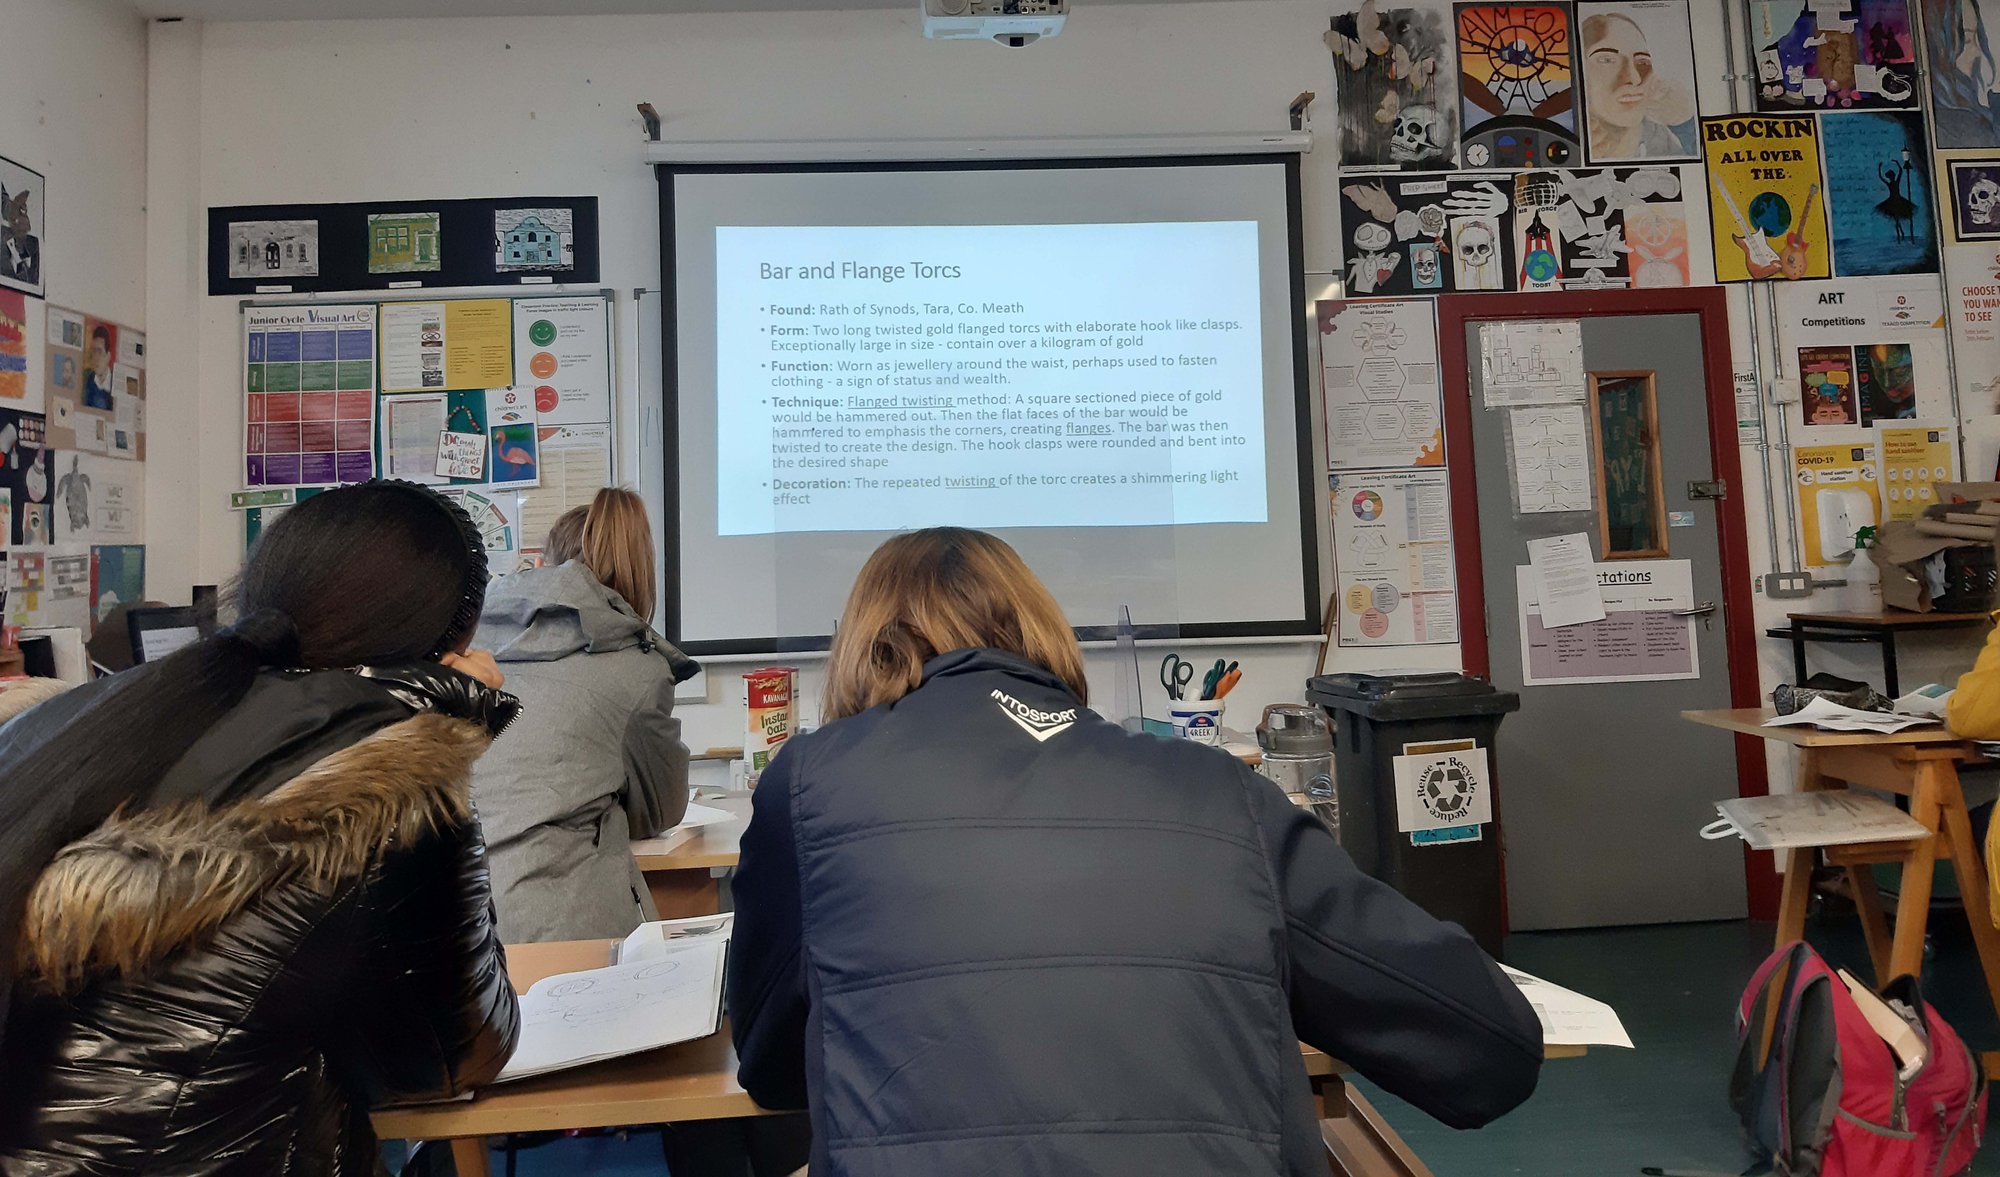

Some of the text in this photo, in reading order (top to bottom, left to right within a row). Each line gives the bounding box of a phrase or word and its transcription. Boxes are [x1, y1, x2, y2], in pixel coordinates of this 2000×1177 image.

[1461, 8, 1565, 51] AIM FOR
[1486, 71, 1559, 110] PEACE
[1705, 120, 1812, 141] ROCKIN
[1721, 150, 1803, 164] ALL OVER
[760, 261, 961, 283] Bar and Flange Torcs
[1818, 292, 1846, 305] ART
[1962, 286, 1996, 297] CHOOSE
[770, 301, 1024, 317] Found: Rath of Synods, Tara, Co. Meath
[1963, 299, 1981, 309] YOU
[250, 309, 356, 326] Junior Cycle Visual Art
[1801, 316, 1867, 329] Competitions
[1965, 311, 1992, 322] TO SEE
[770, 317, 1242, 338] Form: Two long twisted gold flanged torcs with elaborate hook like clasps.
[771, 334, 1143, 354] Exceptionally large in size contain over a kilogram of gold
[771, 353, 1217, 373] Function: Worn as jewellery around the waist, perhaps used to fasten
[771, 372, 1011, 390] clothing a sign of status and wealth.
[1857, 346, 1873, 412] IMAGINE
[771, 388, 1221, 410] Technique: Flanged twisting method: A square sectioned piece of gold
[771, 404, 1188, 423] would be hammered out. Then the flat faces of the bar would be
[847, 426, 861, 438] to
[864, 424, 926, 439] emphasis
[929, 423, 951, 436] the
[954, 426, 1007, 437] corners,
[1010, 422, 1062, 437] creating
[1066, 421, 1114, 436] flanges.
[1118, 420, 1142, 433] The
[1145, 420, 1167, 432] bar
[1170, 423, 1195, 432] was
[1199, 419, 1228, 432] then
[1797, 457, 1835, 465] COVID-19
[772, 468, 1239, 490] Decoration: The repeated twisting of the torc creates a shimmering light
[772, 492, 810, 505] effect
[990, 689, 1077, 723] INTOSPORT
[1416, 764, 1433, 797] Reuse
[1449, 756, 1478, 793] Recycle
[1429, 807, 1468, 823] Reduce
